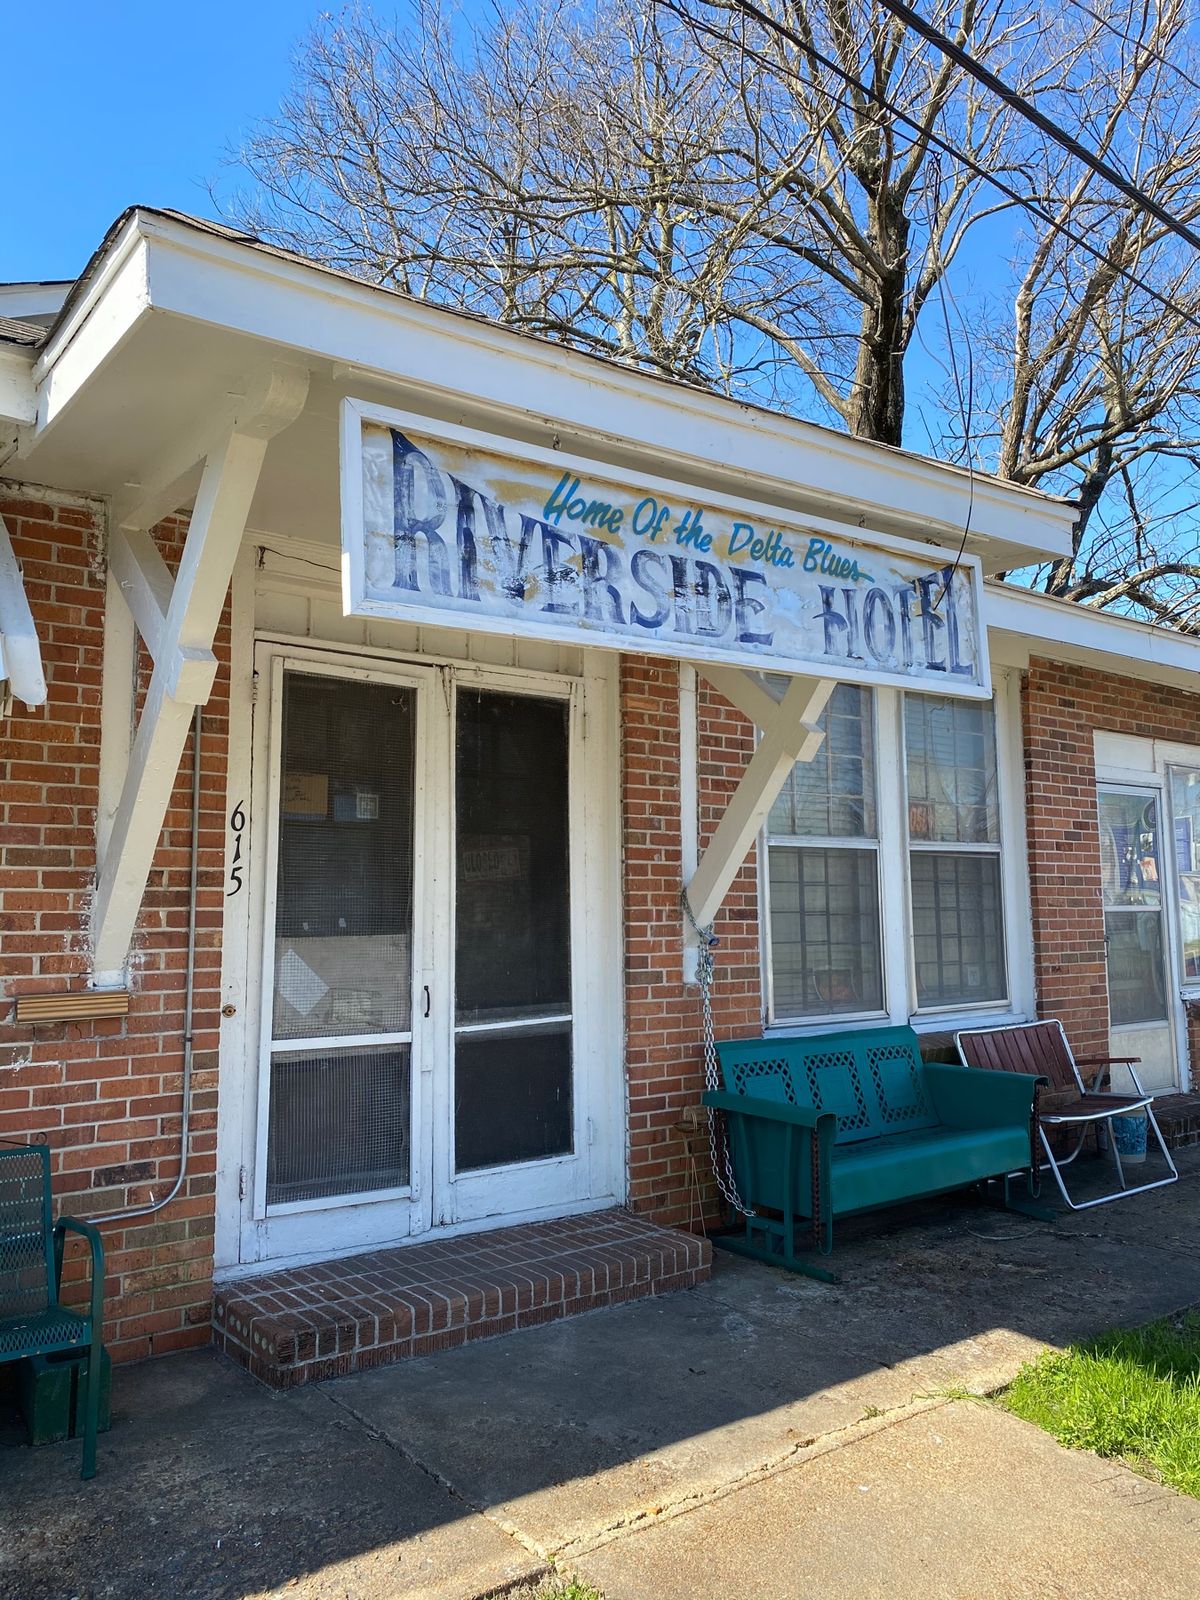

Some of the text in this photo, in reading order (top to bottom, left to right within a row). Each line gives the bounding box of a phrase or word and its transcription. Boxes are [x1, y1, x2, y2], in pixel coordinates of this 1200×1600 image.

[389, 427, 974, 678] RIVERSIDE HOTEL
[543, 472, 875, 584] Home Of the Delta Blues
[226, 799, 246, 897] 615
